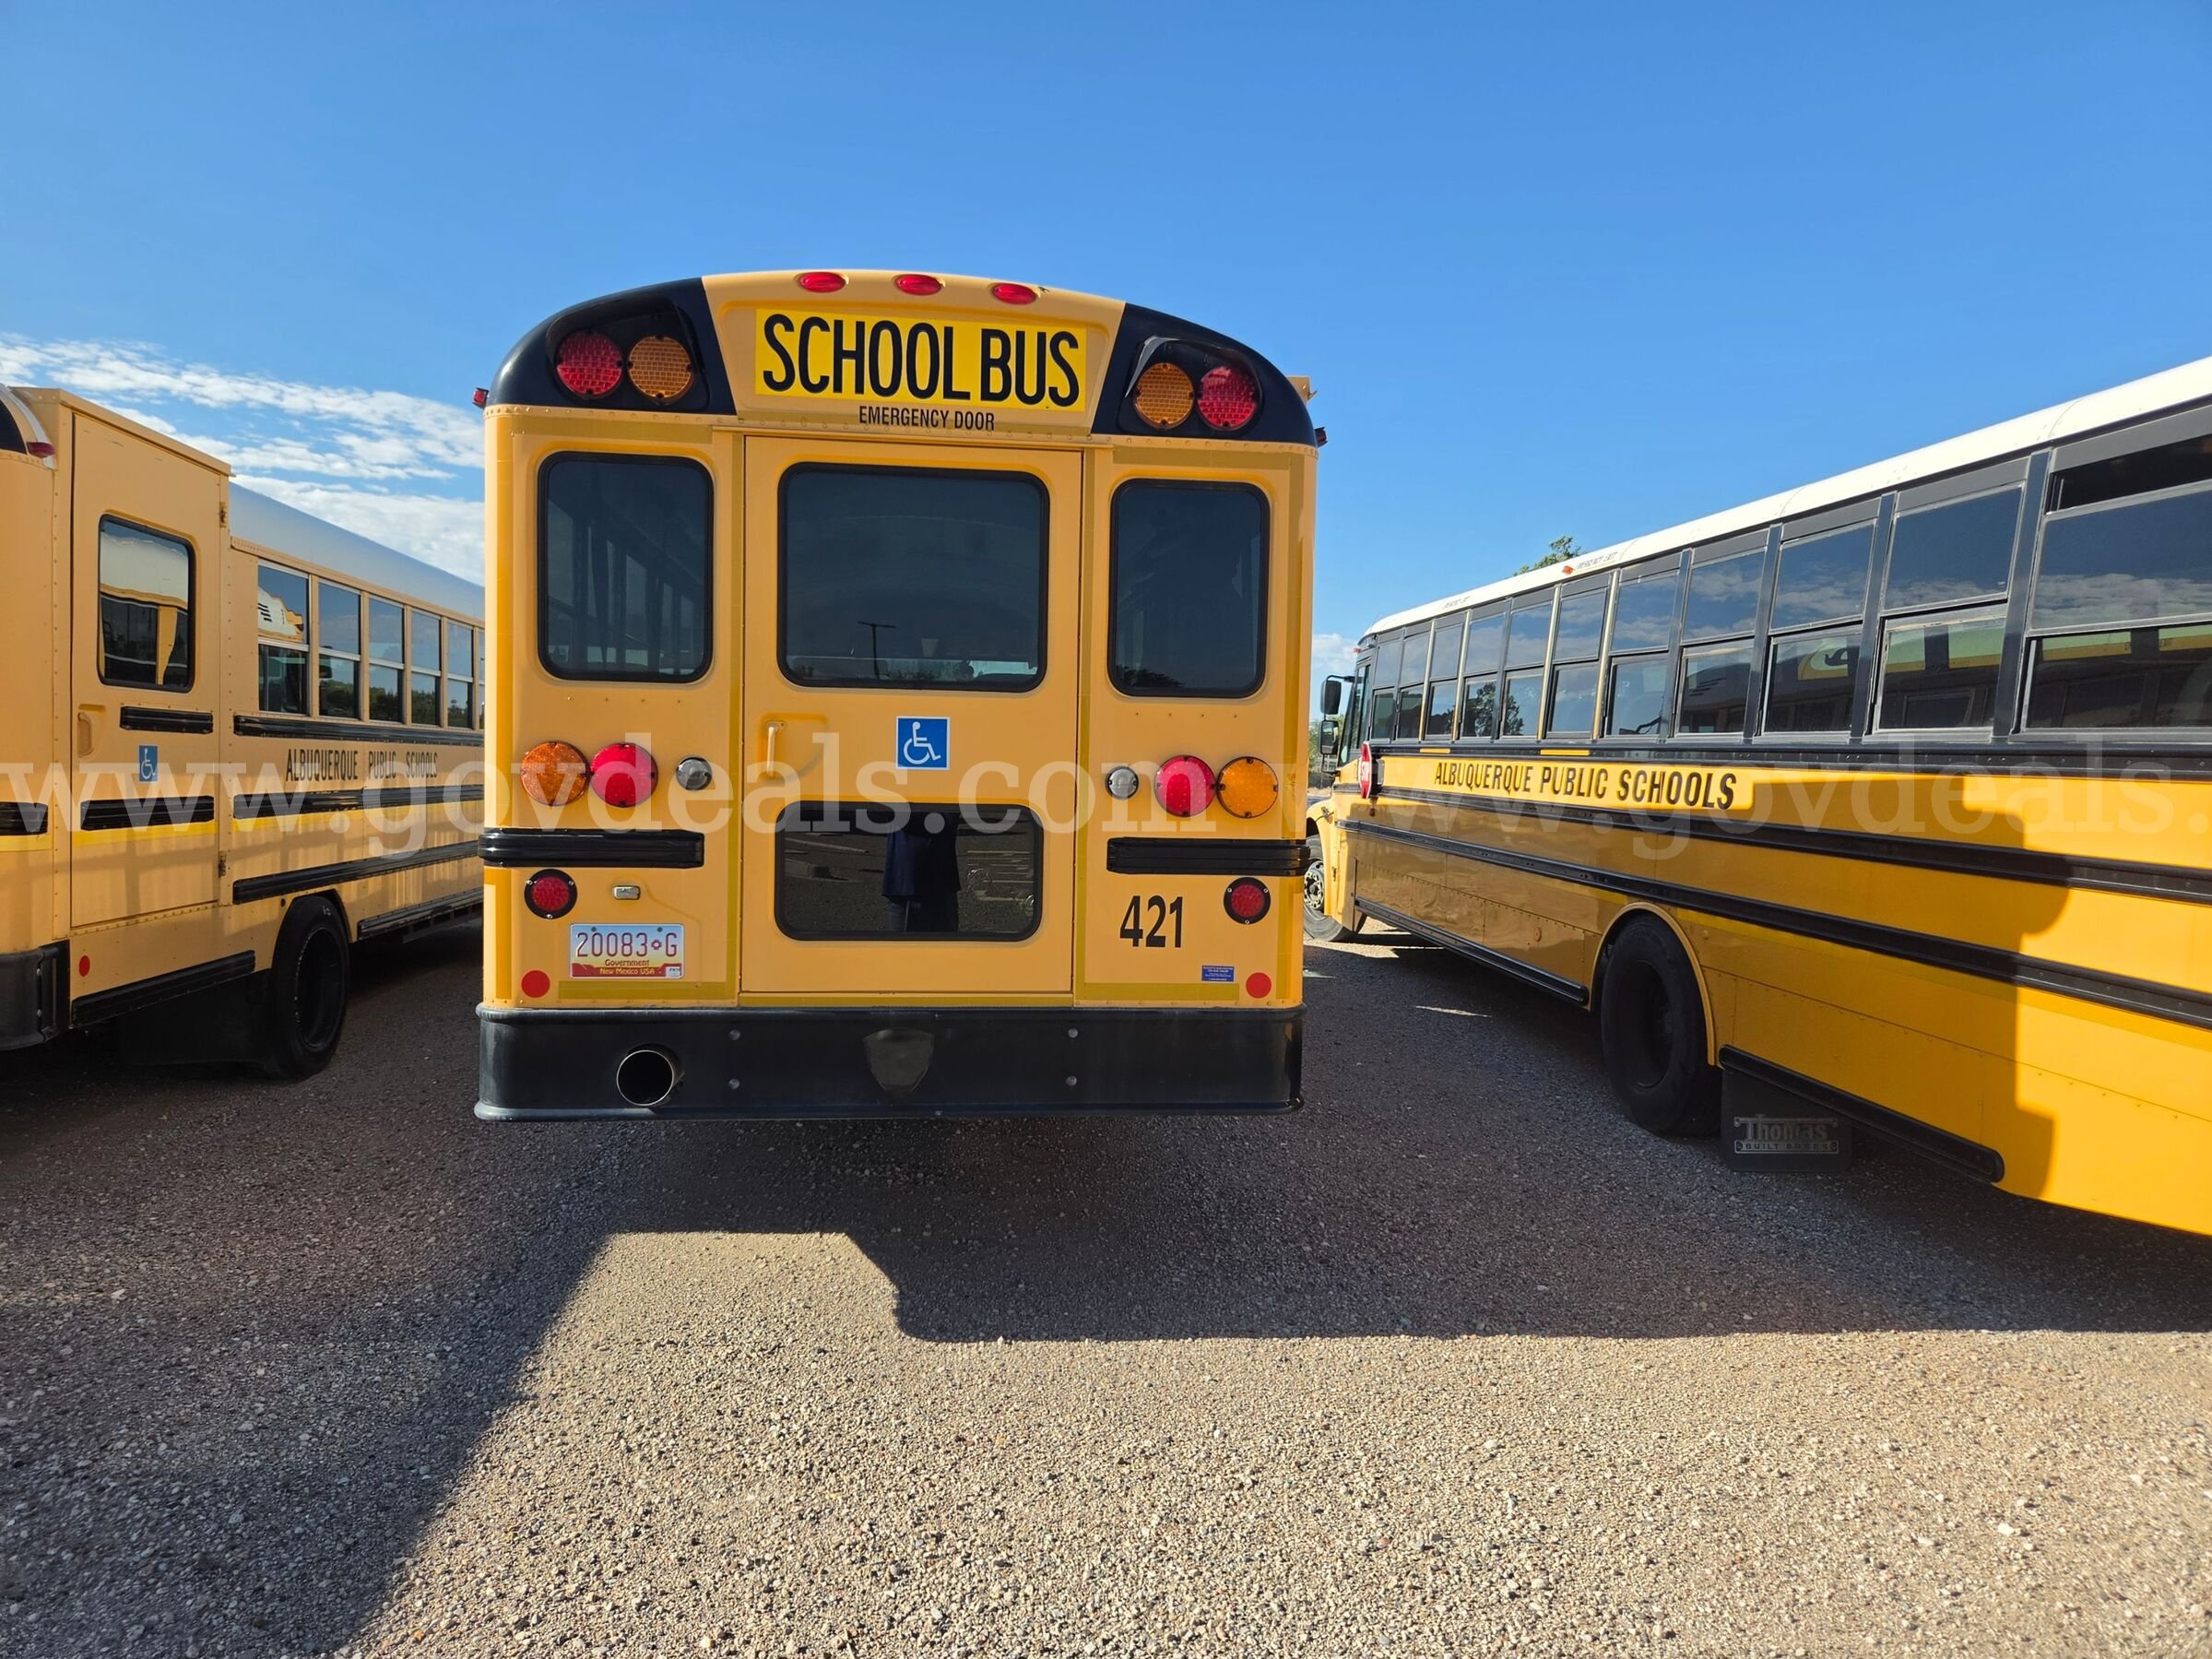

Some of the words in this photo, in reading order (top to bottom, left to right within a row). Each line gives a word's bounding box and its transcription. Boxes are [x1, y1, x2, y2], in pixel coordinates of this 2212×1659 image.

[763, 313, 971, 400] SCHOOL
[979, 327, 1080, 408] BUS
[858, 405, 950, 427] EMERGENCY
[953, 410, 995, 431] DOOR
[286, 749, 359, 782] ALBUQUERQUE
[369, 751, 396, 779] PUBLIC
[406, 752, 439, 778] SCHOOLS
[1434, 762, 1533, 795] ALBUQUERQUE
[1540, 766, 1608, 799] PUBLIC
[1616, 768, 1737, 811] SCHOOLS
[1119, 895, 1183, 948] 421
